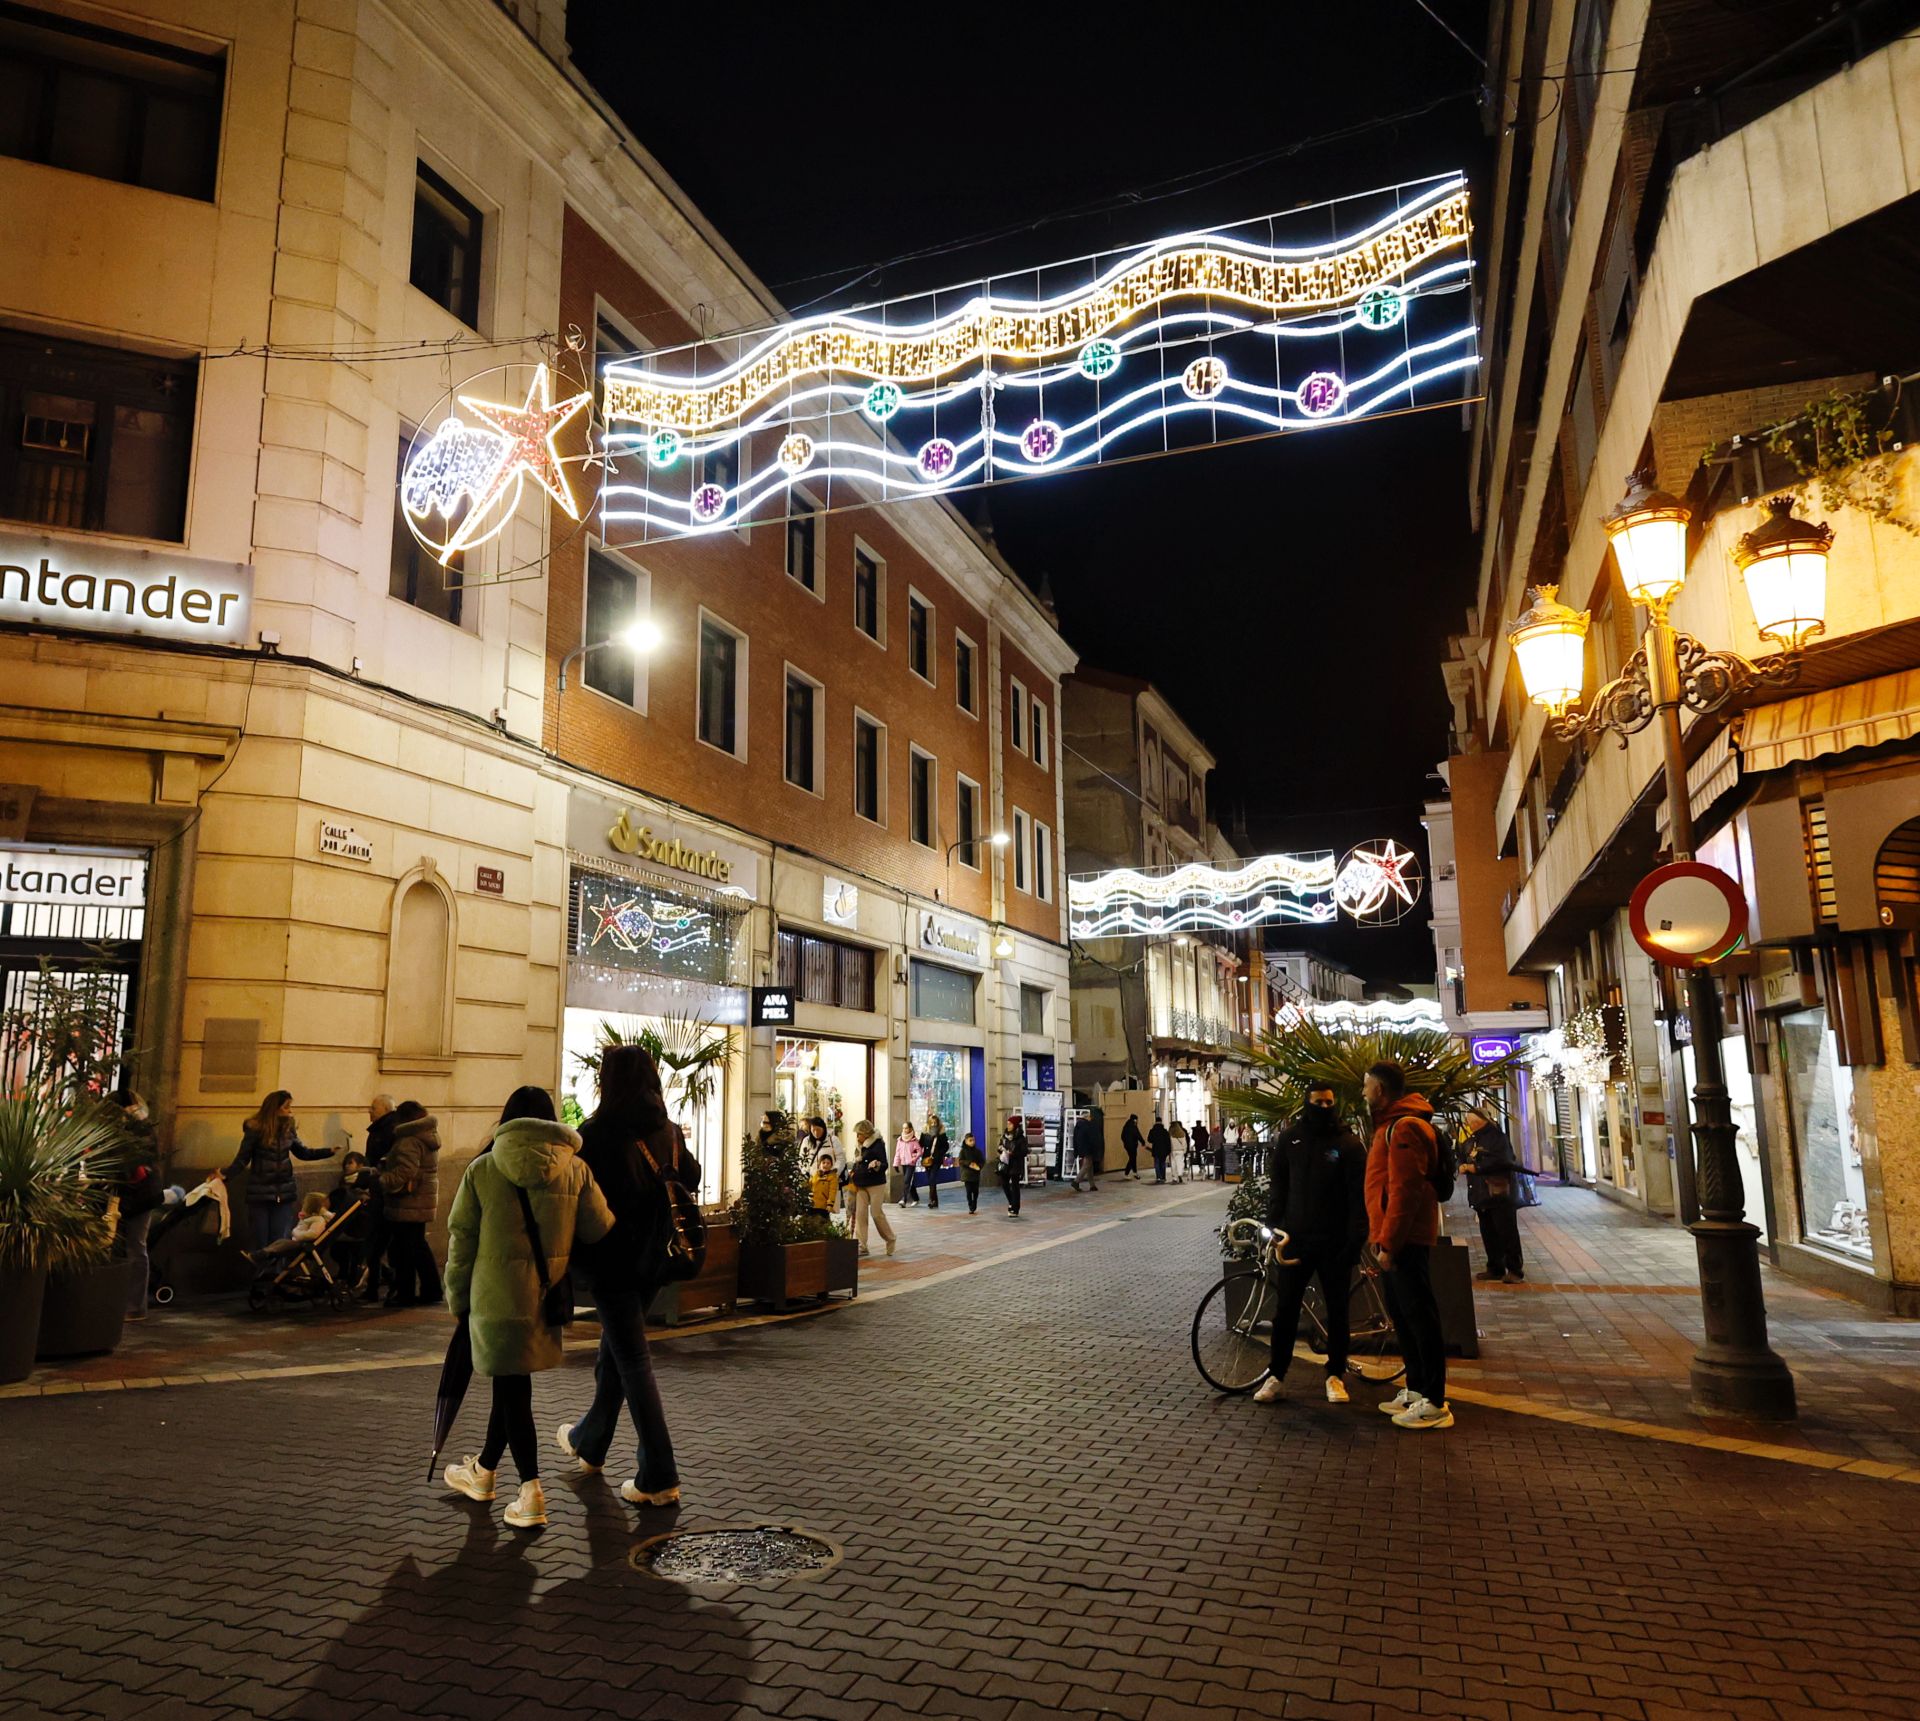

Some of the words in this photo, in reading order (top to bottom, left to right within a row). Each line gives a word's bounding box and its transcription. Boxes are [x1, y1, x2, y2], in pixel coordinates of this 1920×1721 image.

[0, 558, 239, 626] ntander
[324, 825, 347, 840] CALLE
[323, 839, 338, 851] DON
[341, 843, 370, 857] SANCHO
[637, 825, 735, 883] Santander
[0, 862, 132, 898] tander
[763, 994, 788, 1006] ANA
[762, 1007, 789, 1019] PIEL
